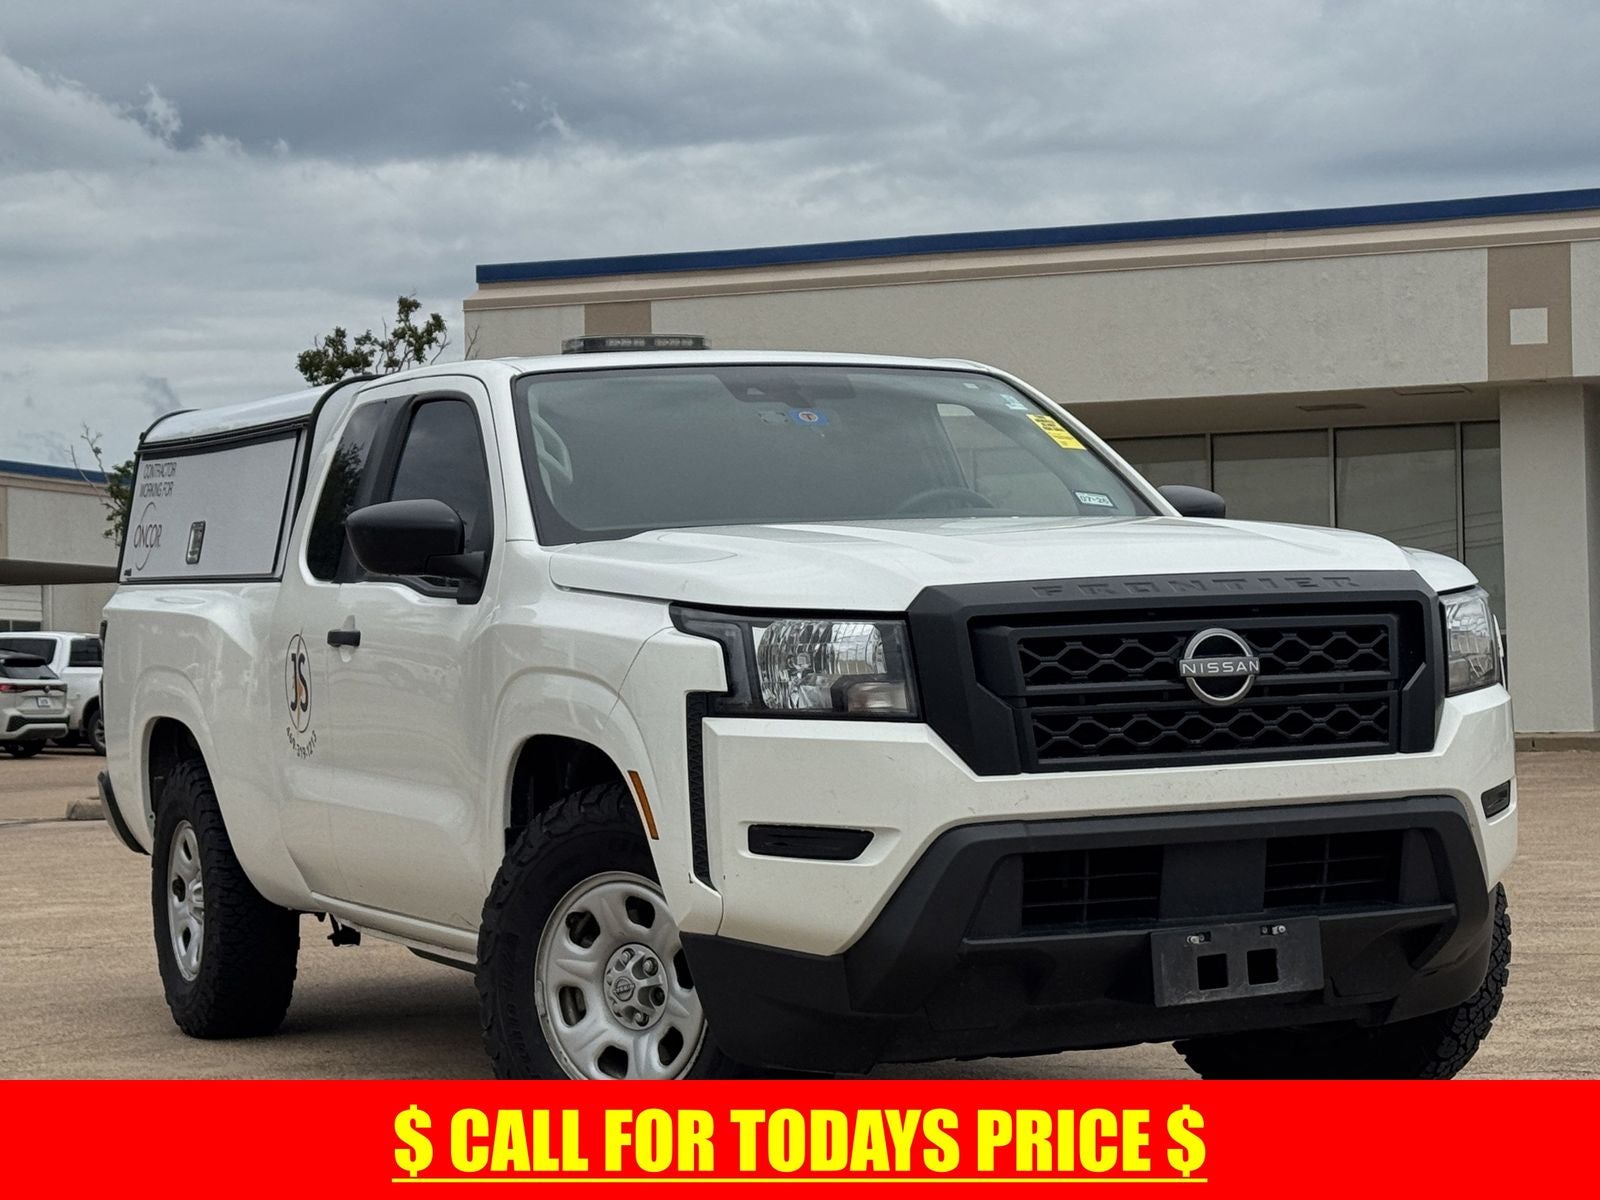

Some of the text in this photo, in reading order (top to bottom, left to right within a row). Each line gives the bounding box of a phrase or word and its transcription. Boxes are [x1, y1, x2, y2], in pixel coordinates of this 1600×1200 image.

[143, 463, 177, 479] CONTRACTOR
[140, 481, 174, 497] WORKING FOR
[134, 524, 162, 548] ONCOR
[1032, 575, 1359, 598] FRONTIER
[1181, 658, 1260, 675] NISSAN
